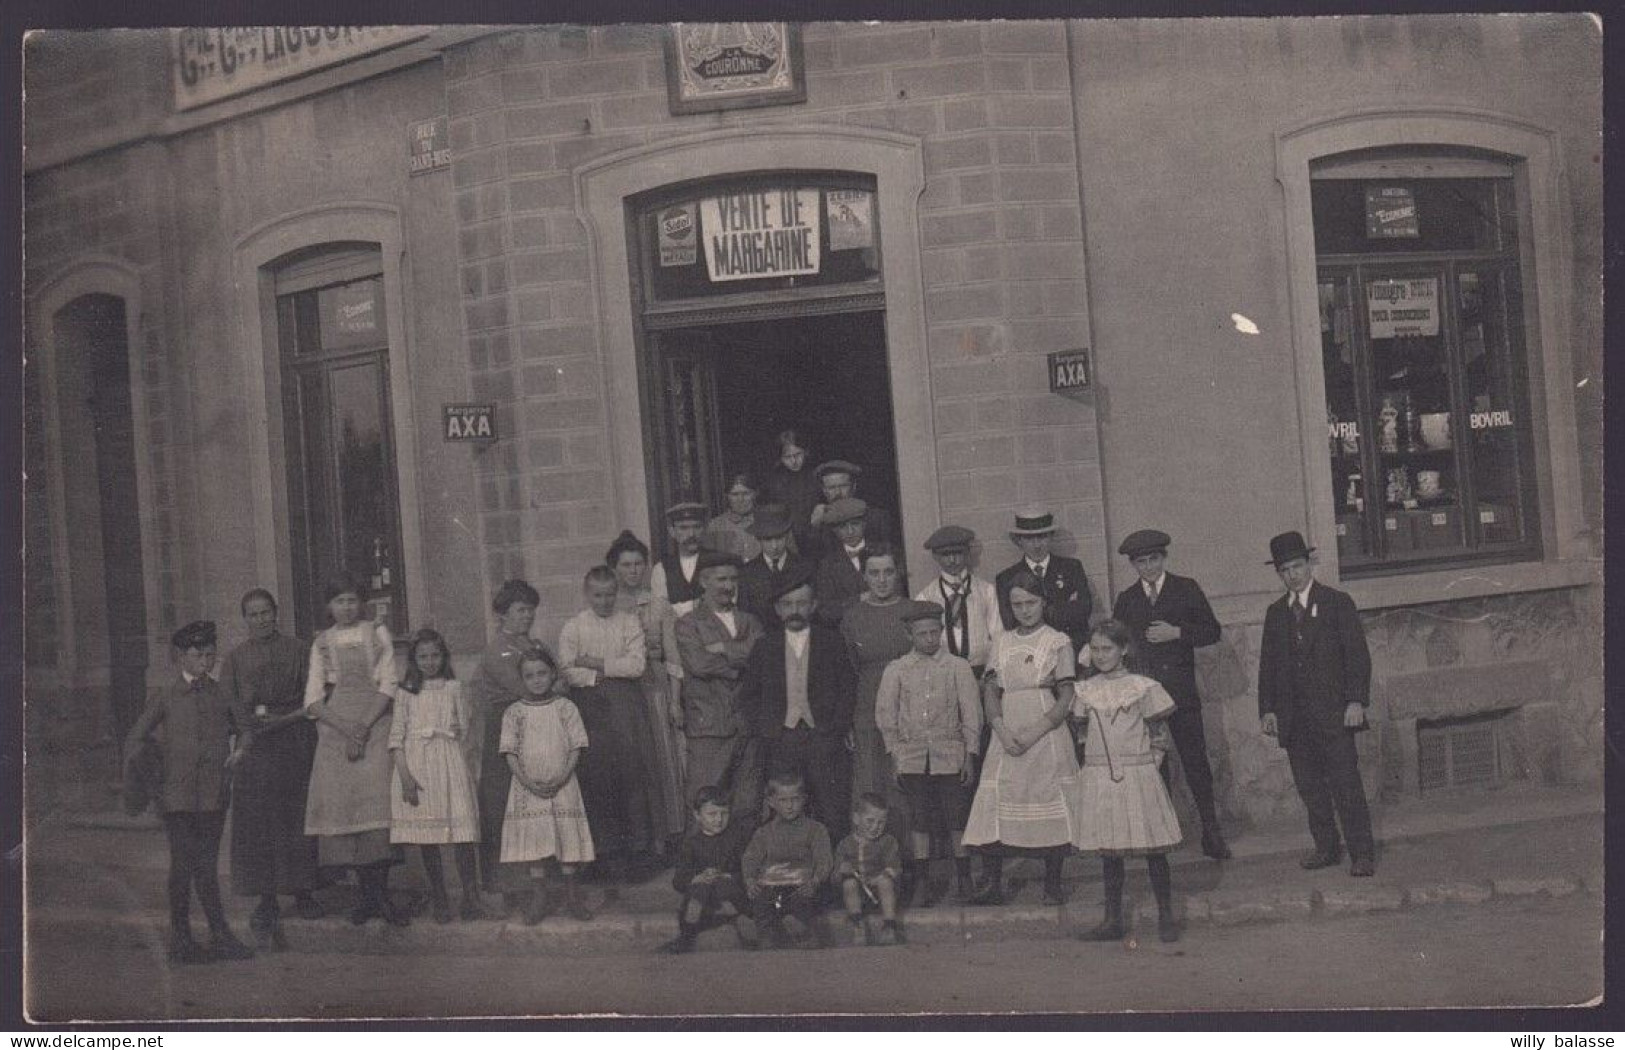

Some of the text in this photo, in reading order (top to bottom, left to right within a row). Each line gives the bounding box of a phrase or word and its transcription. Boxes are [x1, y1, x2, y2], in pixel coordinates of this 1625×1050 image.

[705, 57, 761, 76] COURONNE
[717, 188, 806, 232] VENTE DE
[713, 228, 815, 276] MARGARINE
[1056, 362, 1086, 388] AXA
[447, 415, 492, 438] AXA
[1328, 421, 1361, 438] VRIL
[1470, 411, 1513, 429] BOVRIL
